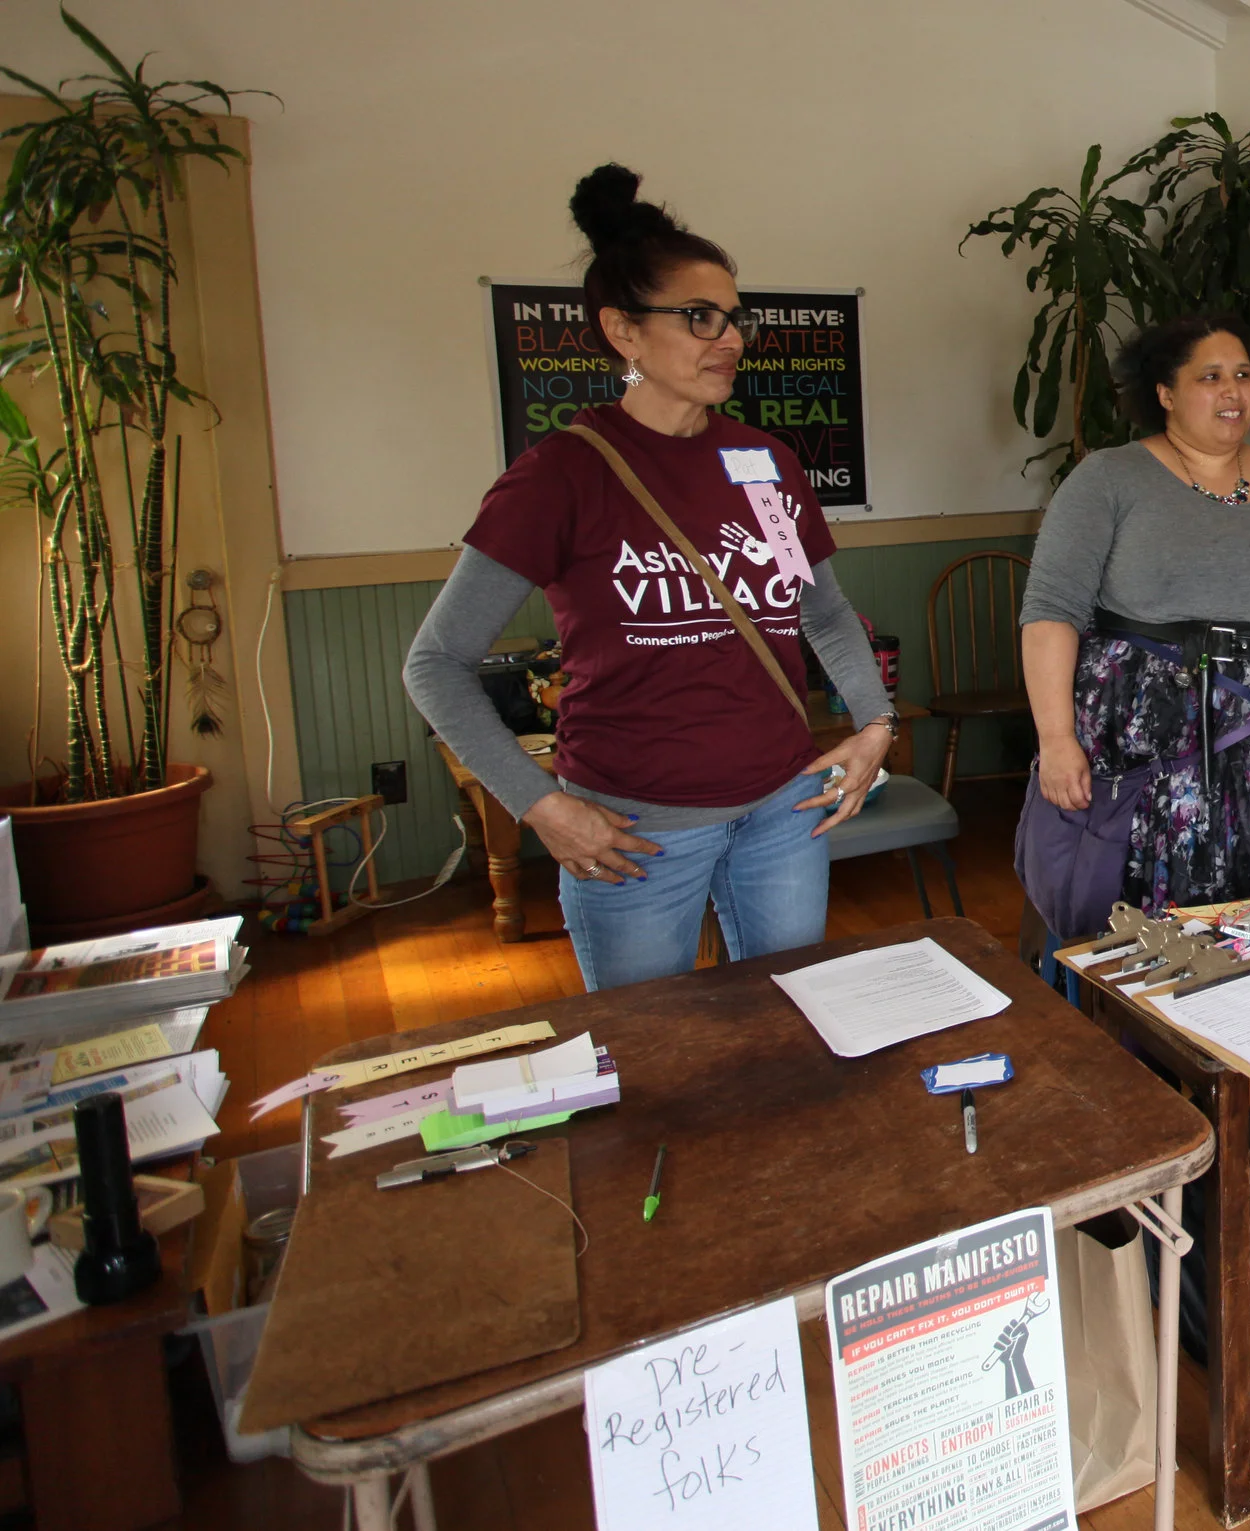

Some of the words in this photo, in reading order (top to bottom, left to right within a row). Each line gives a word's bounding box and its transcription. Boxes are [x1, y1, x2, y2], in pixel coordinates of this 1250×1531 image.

[514, 303, 542, 321] IN
[549, 304, 588, 322] TH
[517, 326, 600, 352] BLAC
[518, 358, 610, 372] WOMEN'S
[736, 359, 784, 371] UMAN
[792, 359, 845, 371] RIGHTS
[523, 376, 573, 399] NO
[588, 376, 626, 398] HU
[747, 375, 846, 396] ILLEGAL
[760, 400, 848, 426] REAL
[768, 427, 849, 464] OVE
[806, 468, 851, 488] ING
[761, 497, 793, 558] HOST
[612, 574, 803, 615] VILLAG
[626, 632, 699, 646] Connecting
[372, 1036, 502, 1072] FIXER
[840, 1271, 917, 1322] REPAIR
[923, 1228, 1037, 1293] MANIFESTO
[954, 1286, 964, 1295] TO
[852, 1347, 860, 1356] IF
[863, 1337, 883, 1350] YOU
[886, 1325, 915, 1342] CAN'T
[918, 1318, 934, 1330] FIX
[951, 1305, 970, 1318] YOU
[974, 1294, 1000, 1310] DON'T
[1004, 1286, 1023, 1299] OWN
[1027, 1281, 1037, 1291] IT.
[848, 1360, 875, 1377] REPAIR
[877, 1355, 884, 1364] IS
[887, 1344, 915, 1359] BETTER
[918, 1336, 938, 1347] THAN
[940, 1320, 981, 1339] RECYCLING
[850, 1384, 878, 1402] REPAIR
[881, 1372, 906, 1387] SAVES
[909, 1364, 924, 1375] YOU
[927, 1353, 954, 1369] MONEY
[601, 1349, 785, 1452] Registered
[852, 1408, 879, 1426] REPAIR
[883, 1391, 918, 1411] TEACHES
[921, 1370, 972, 1395] ENGINEERING
[1004, 1392, 1039, 1419] REPAIR
[1044, 1387, 1053, 1403] IS
[1006, 1400, 1055, 1431] SUSTAINABLE
[854, 1427, 881, 1444] REPAIR
[885, 1413, 909, 1429] SAVES
[913, 1406, 927, 1416] THE
[930, 1394, 958, 1410] PLANET
[940, 1424, 960, 1439] REPAIR
[971, 1414, 983, 1426] WAR
[984, 1410, 993, 1421] ON
[941, 1419, 993, 1456] ENTROPY
[968, 1453, 976, 1466] TO
[980, 1439, 1009, 1461] CHOOSE
[1017, 1426, 1056, 1451] FASTENERS
[653, 1435, 760, 1511] folks
[865, 1437, 928, 1480] CONNECTS
[867, 1473, 889, 1490] PEOPLE
[892, 1465, 905, 1477] AND
[908, 1454, 928, 1470] THINGS
[1000, 1460, 1010, 1470] NOT
[876, 1487, 899, 1504] DEVICES
[902, 1480, 915, 1491] THAT
[917, 1473, 929, 1484] CAN
[941, 1459, 962, 1474] OPENED
[878, 1502, 898, 1518] REPAIR
[901, 1479, 951, 1507] DOCUMENTATION
[953, 1473, 964, 1484] FOR
[975, 1479, 993, 1497] ANY
[995, 1474, 1003, 1488] &
[1005, 1467, 1020, 1484] ALL
[1030, 1487, 1060, 1507] INSPIRES
[869, 1483, 967, 1531] VERYTHING
